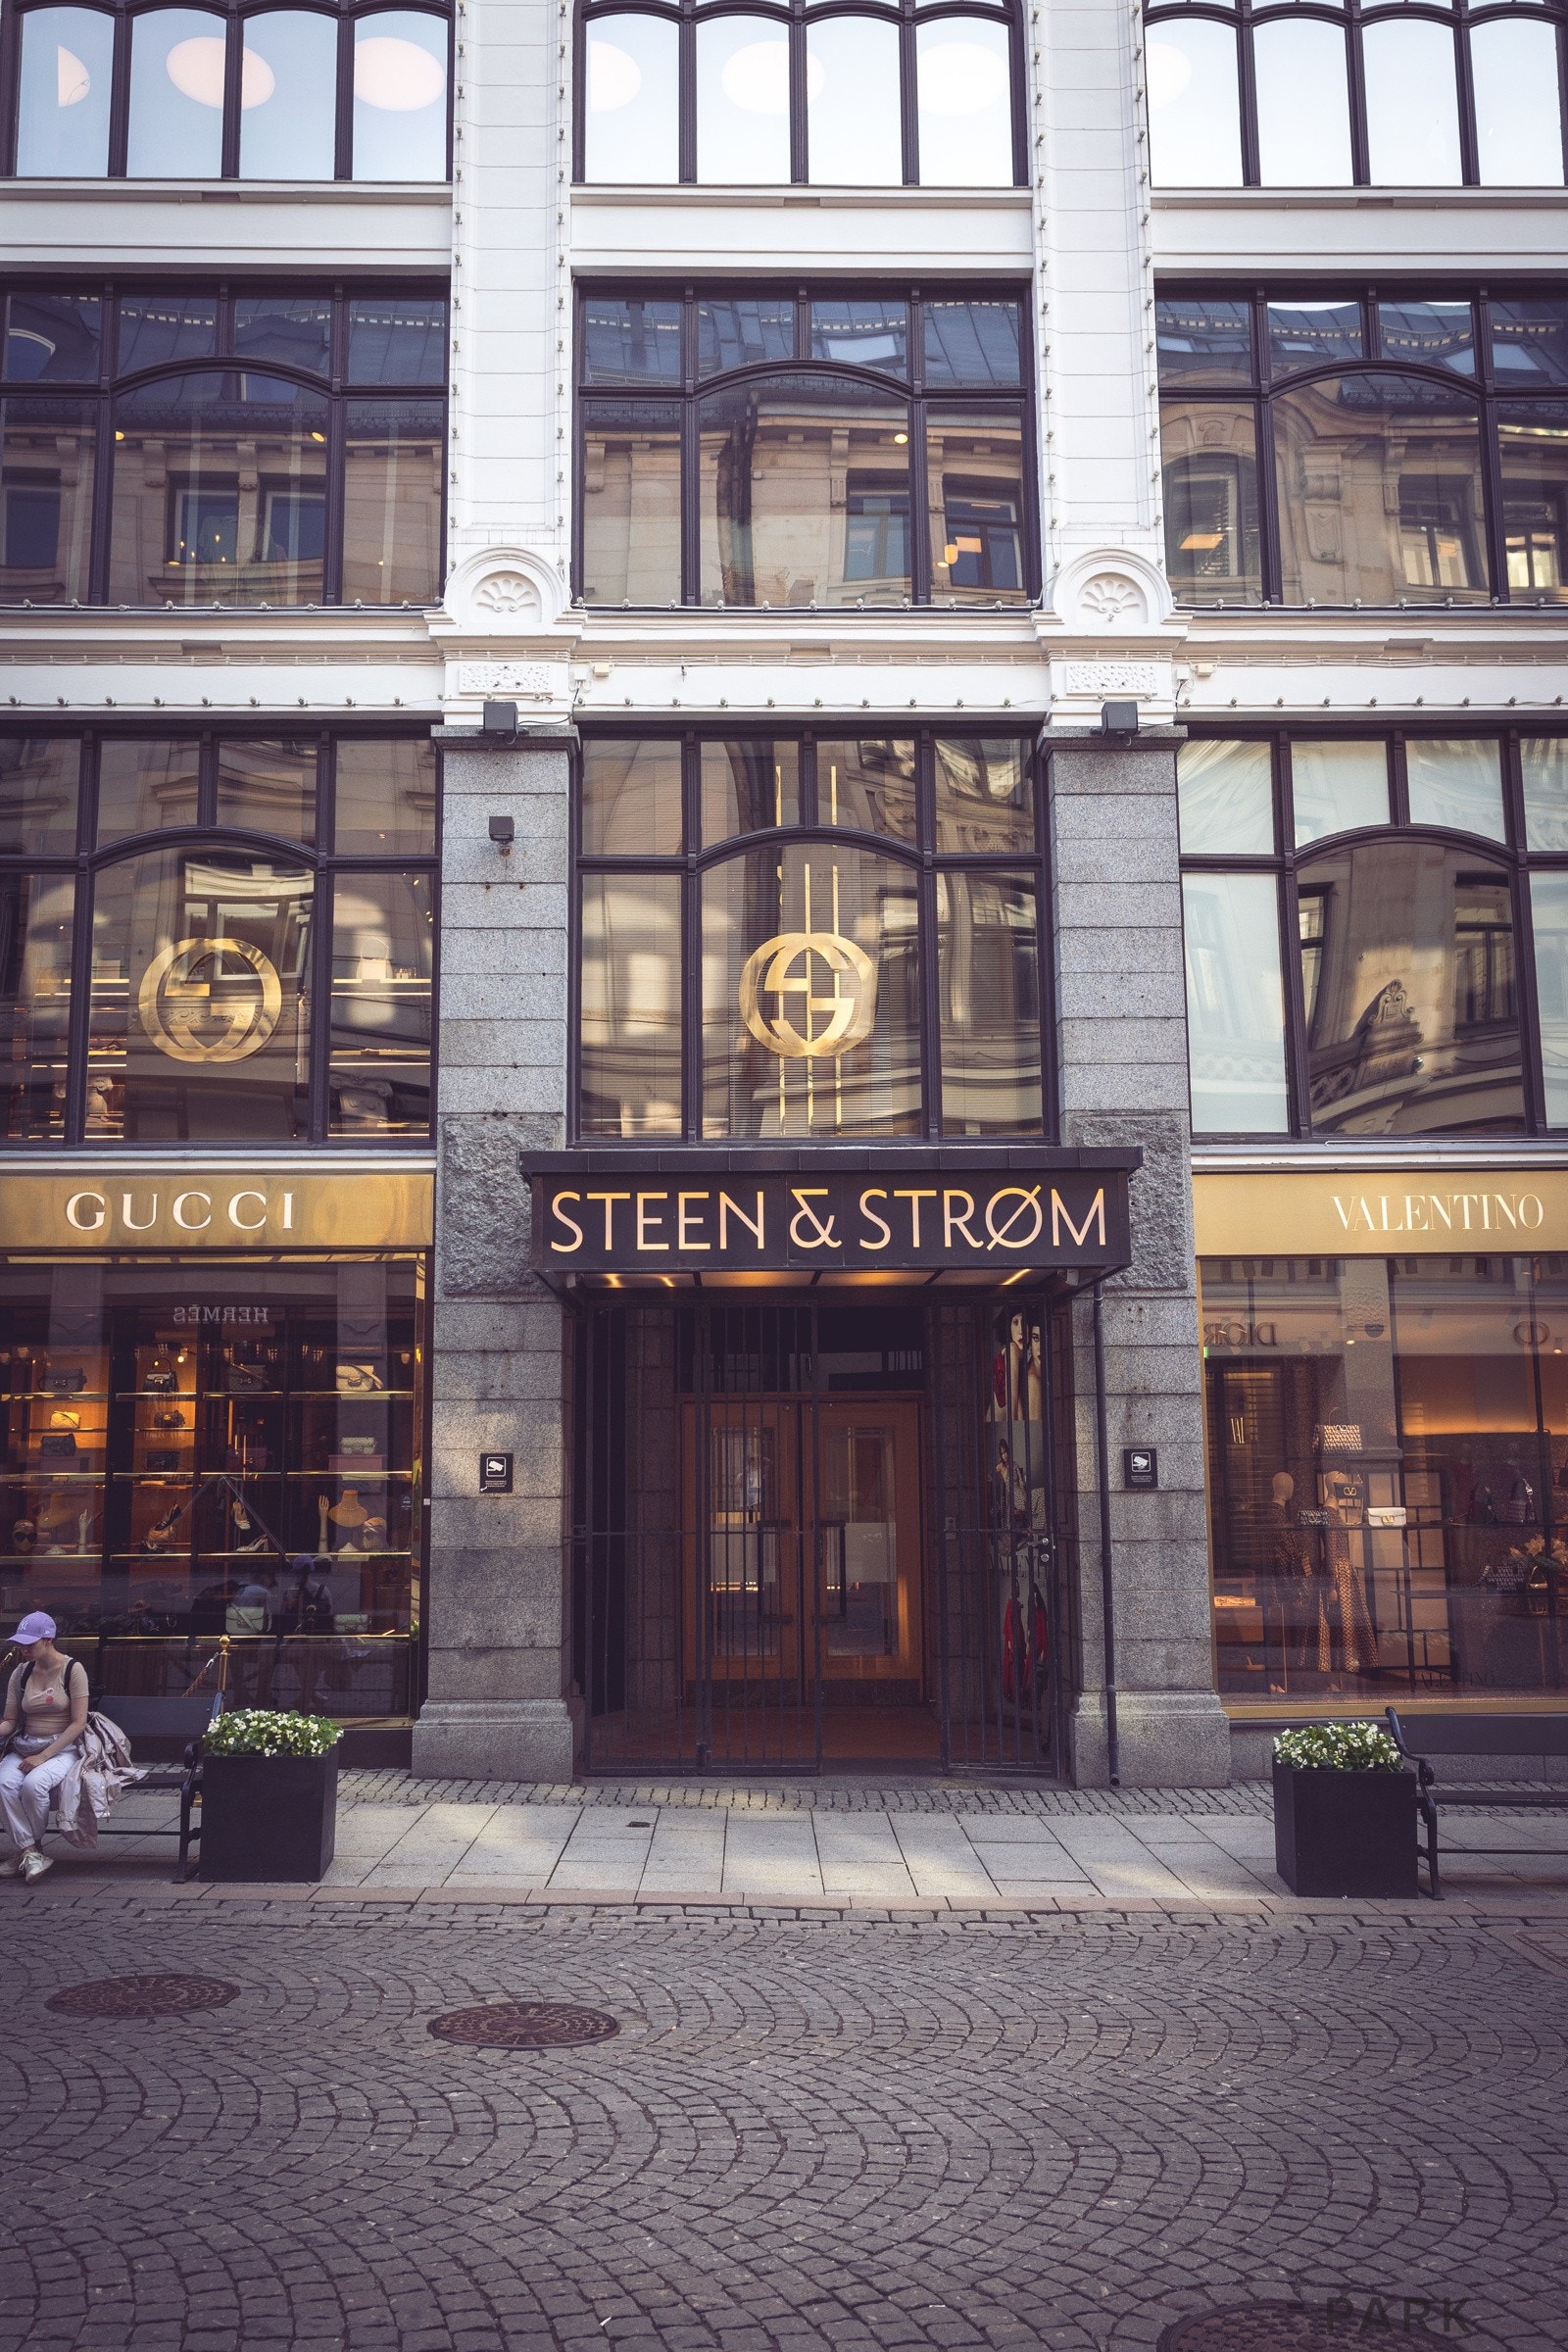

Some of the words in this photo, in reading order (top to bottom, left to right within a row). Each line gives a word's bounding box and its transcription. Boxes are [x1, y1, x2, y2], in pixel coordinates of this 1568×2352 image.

[66, 1191, 293, 1230] GUCCI
[551, 1191, 764, 1252] STEEN
[789, 1189, 842, 1249] &
[858, 1184, 1106, 1251] STRØM
[1330, 1194, 1544, 1231] VALENTINO
